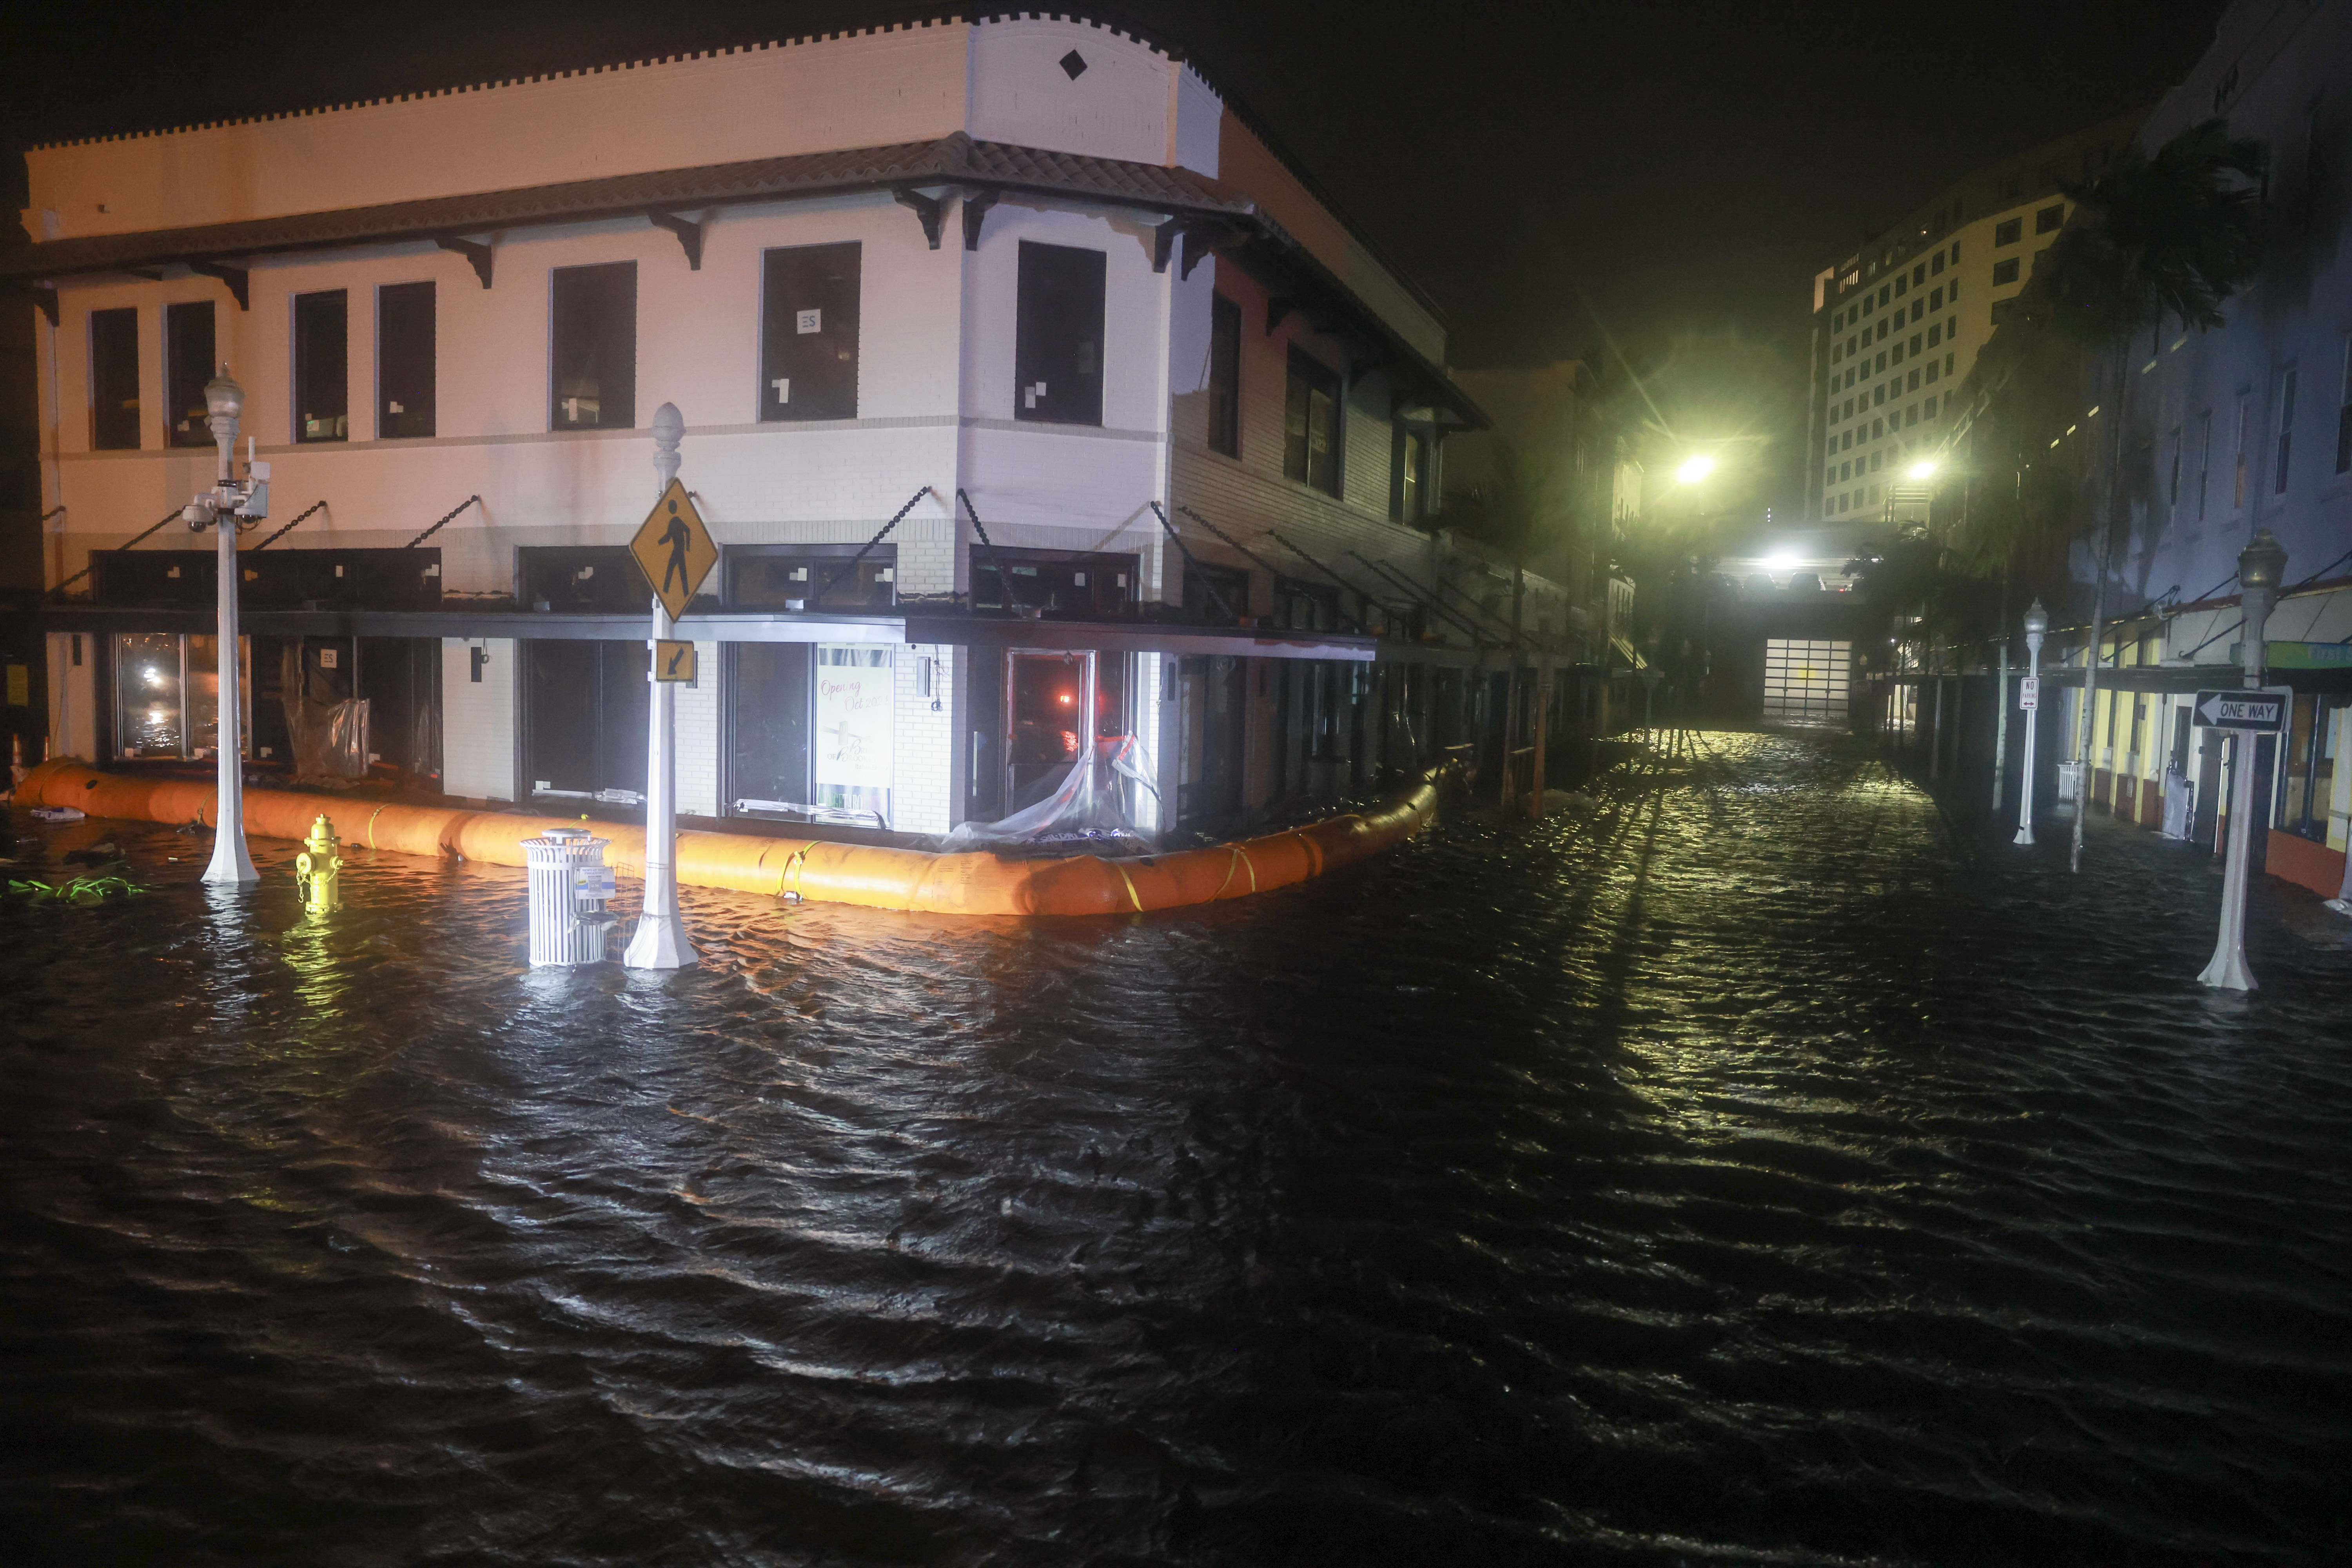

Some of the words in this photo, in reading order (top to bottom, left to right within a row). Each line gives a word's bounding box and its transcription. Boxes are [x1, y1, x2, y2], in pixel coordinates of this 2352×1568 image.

[821, 679, 862, 701] Opening
[2026, 681, 2034, 690] NO
[844, 696, 863, 712] Oct
[2221, 703, 2245, 717] ONE
[2249, 705, 2274, 719] WAY
[837, 746, 880, 762] BROOKLY
[849, 739, 877, 755] BRUN
